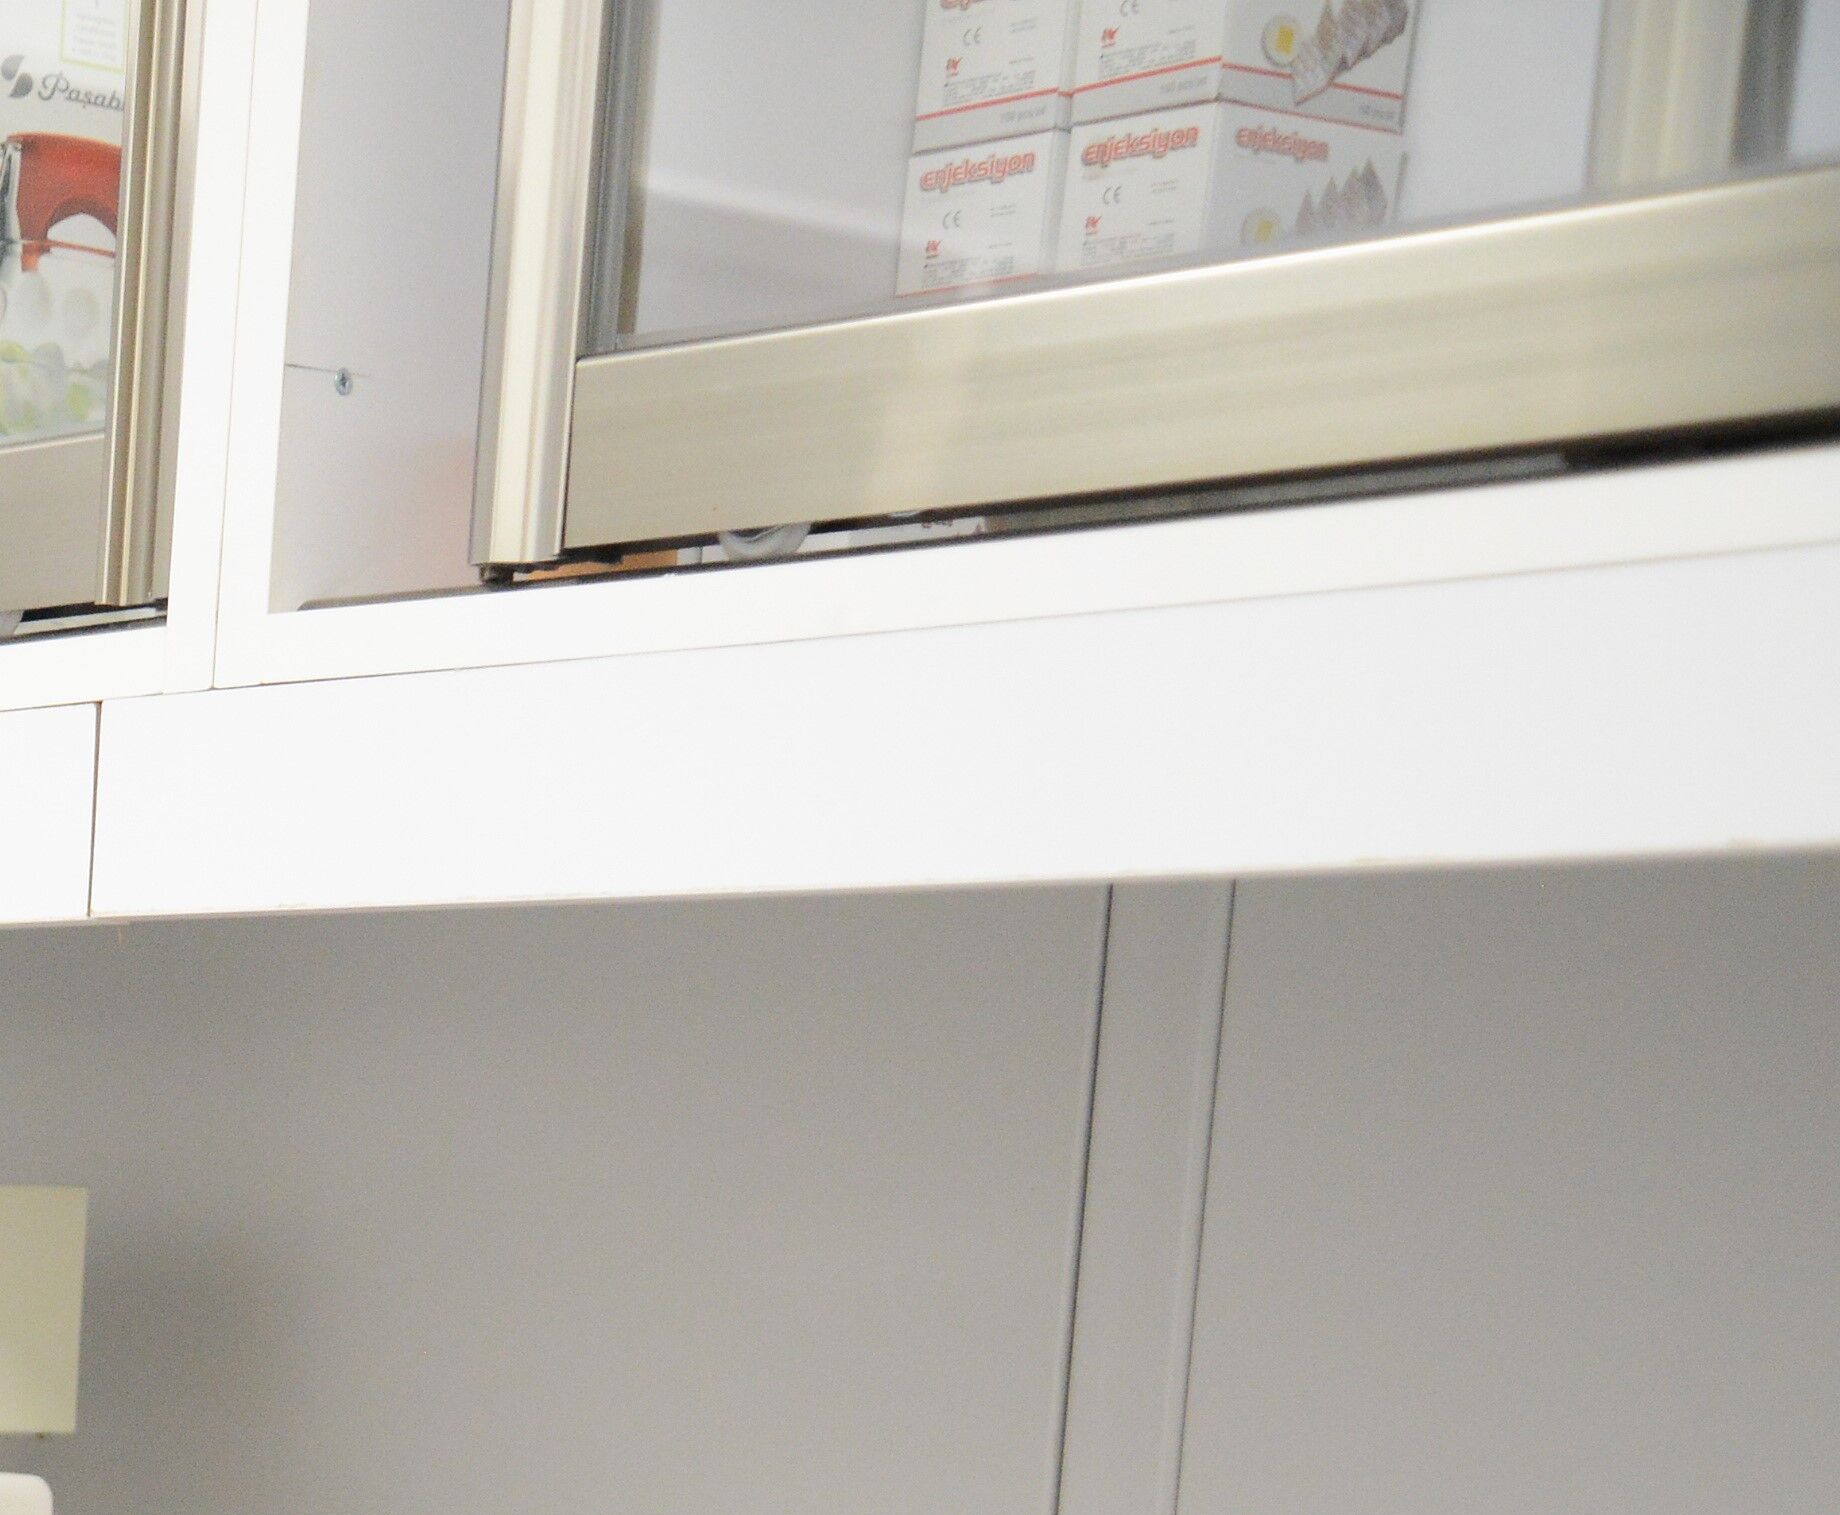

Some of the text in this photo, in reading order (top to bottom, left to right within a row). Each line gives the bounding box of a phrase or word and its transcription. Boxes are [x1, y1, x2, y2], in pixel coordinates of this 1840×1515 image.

[37, 71, 125, 112] Paşab
[1080, 125, 1200, 168] enjeksiyon
[920, 150, 1036, 193] enjeksiyon
